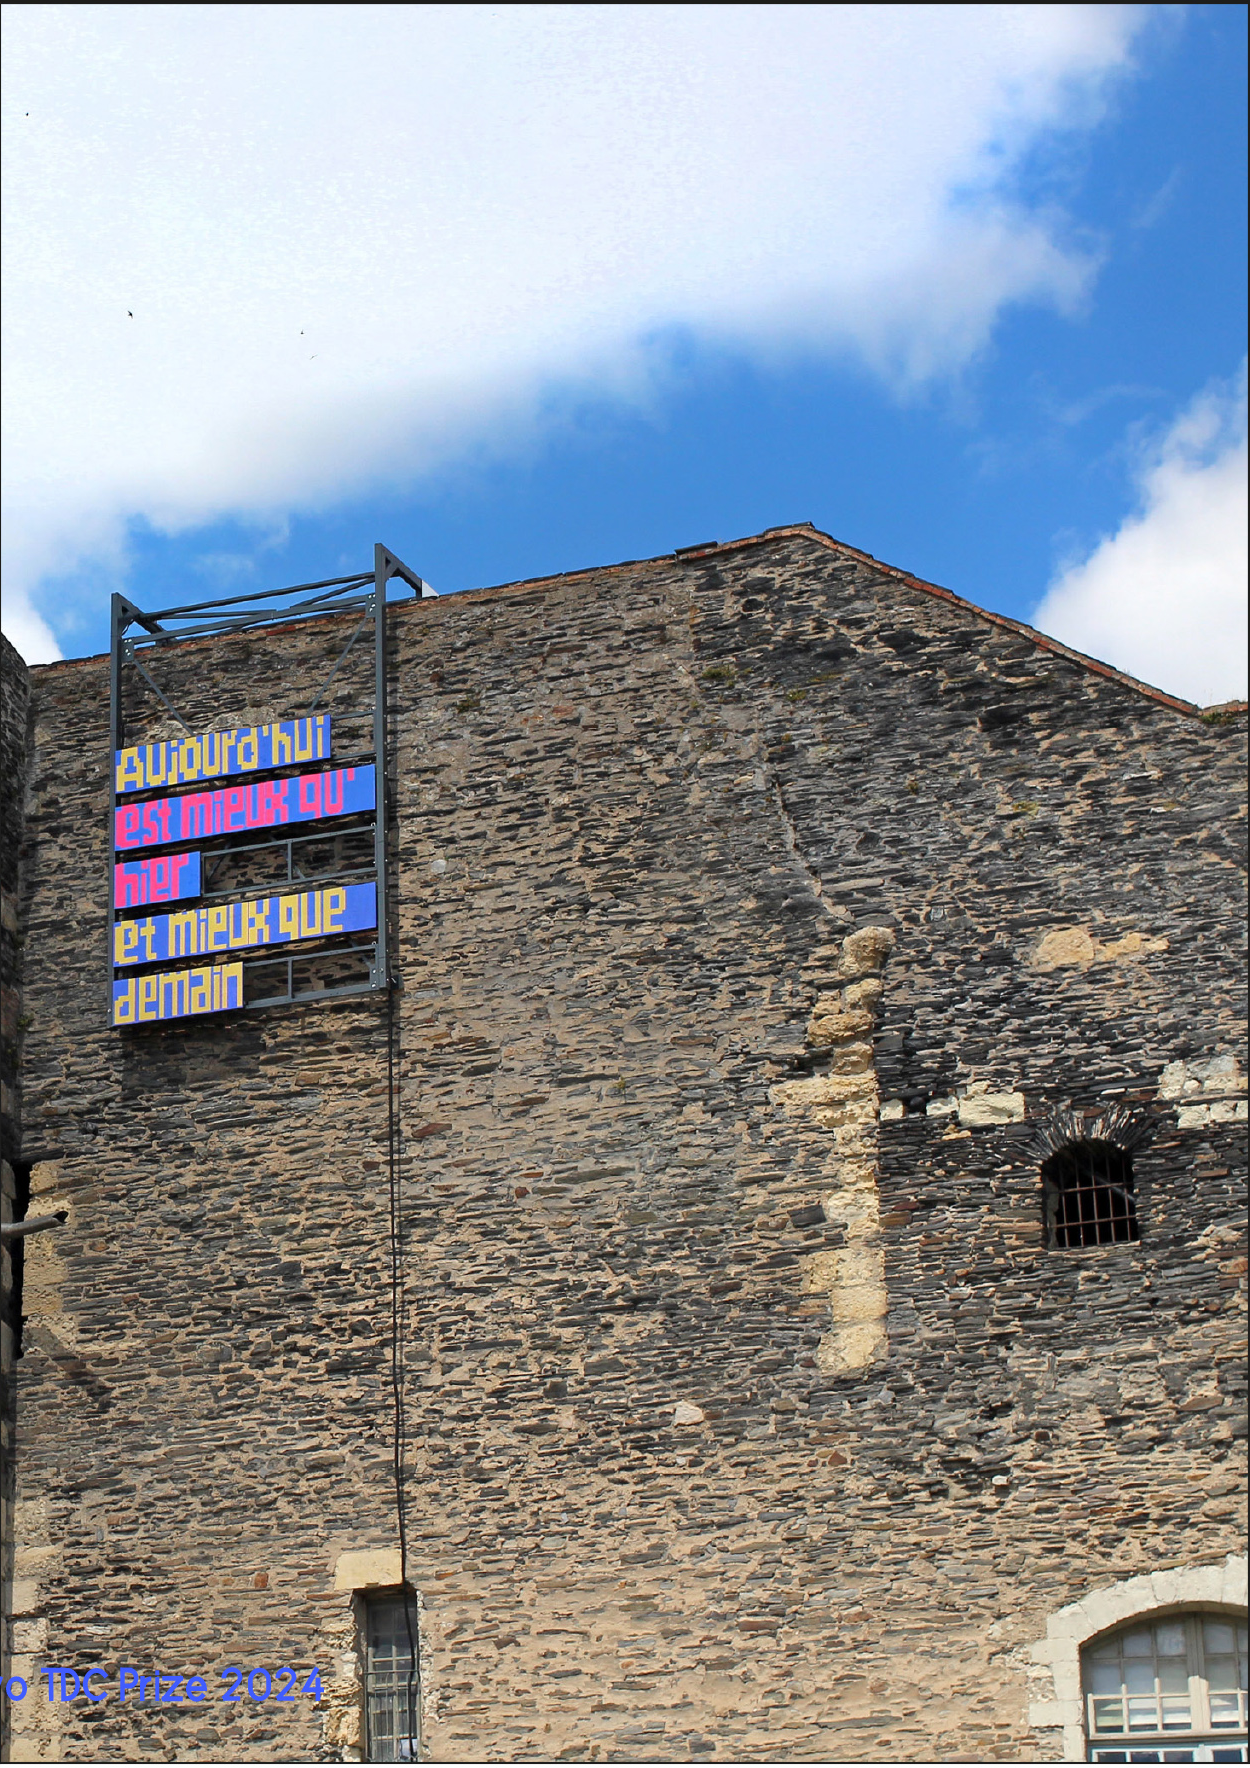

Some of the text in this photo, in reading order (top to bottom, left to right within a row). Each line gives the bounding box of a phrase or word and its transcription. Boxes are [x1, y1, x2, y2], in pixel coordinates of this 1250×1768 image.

[116, 797, 171, 848] est
[181, 779, 288, 838] mieux
[115, 853, 189, 908] hier
[115, 887, 347, 964] et mieux que
[115, 962, 242, 1025] demain
